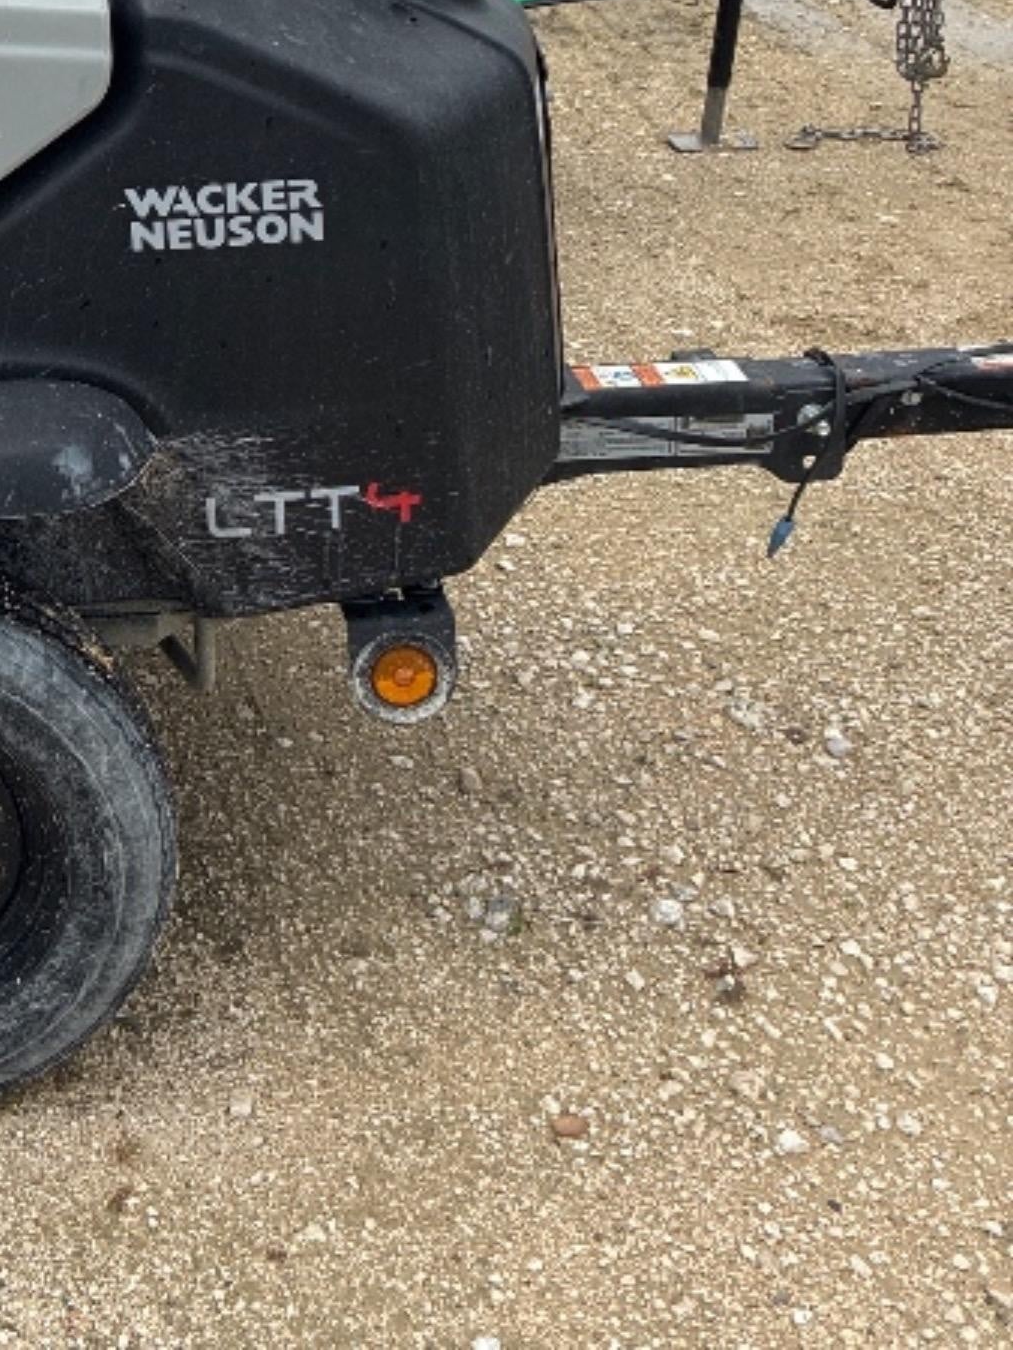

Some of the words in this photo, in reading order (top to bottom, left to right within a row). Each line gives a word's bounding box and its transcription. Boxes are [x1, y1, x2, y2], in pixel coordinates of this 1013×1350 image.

[124, 179, 324, 218] WACKER
[130, 211, 324, 252] NEUSON
[205, 482, 422, 538] LTT4
